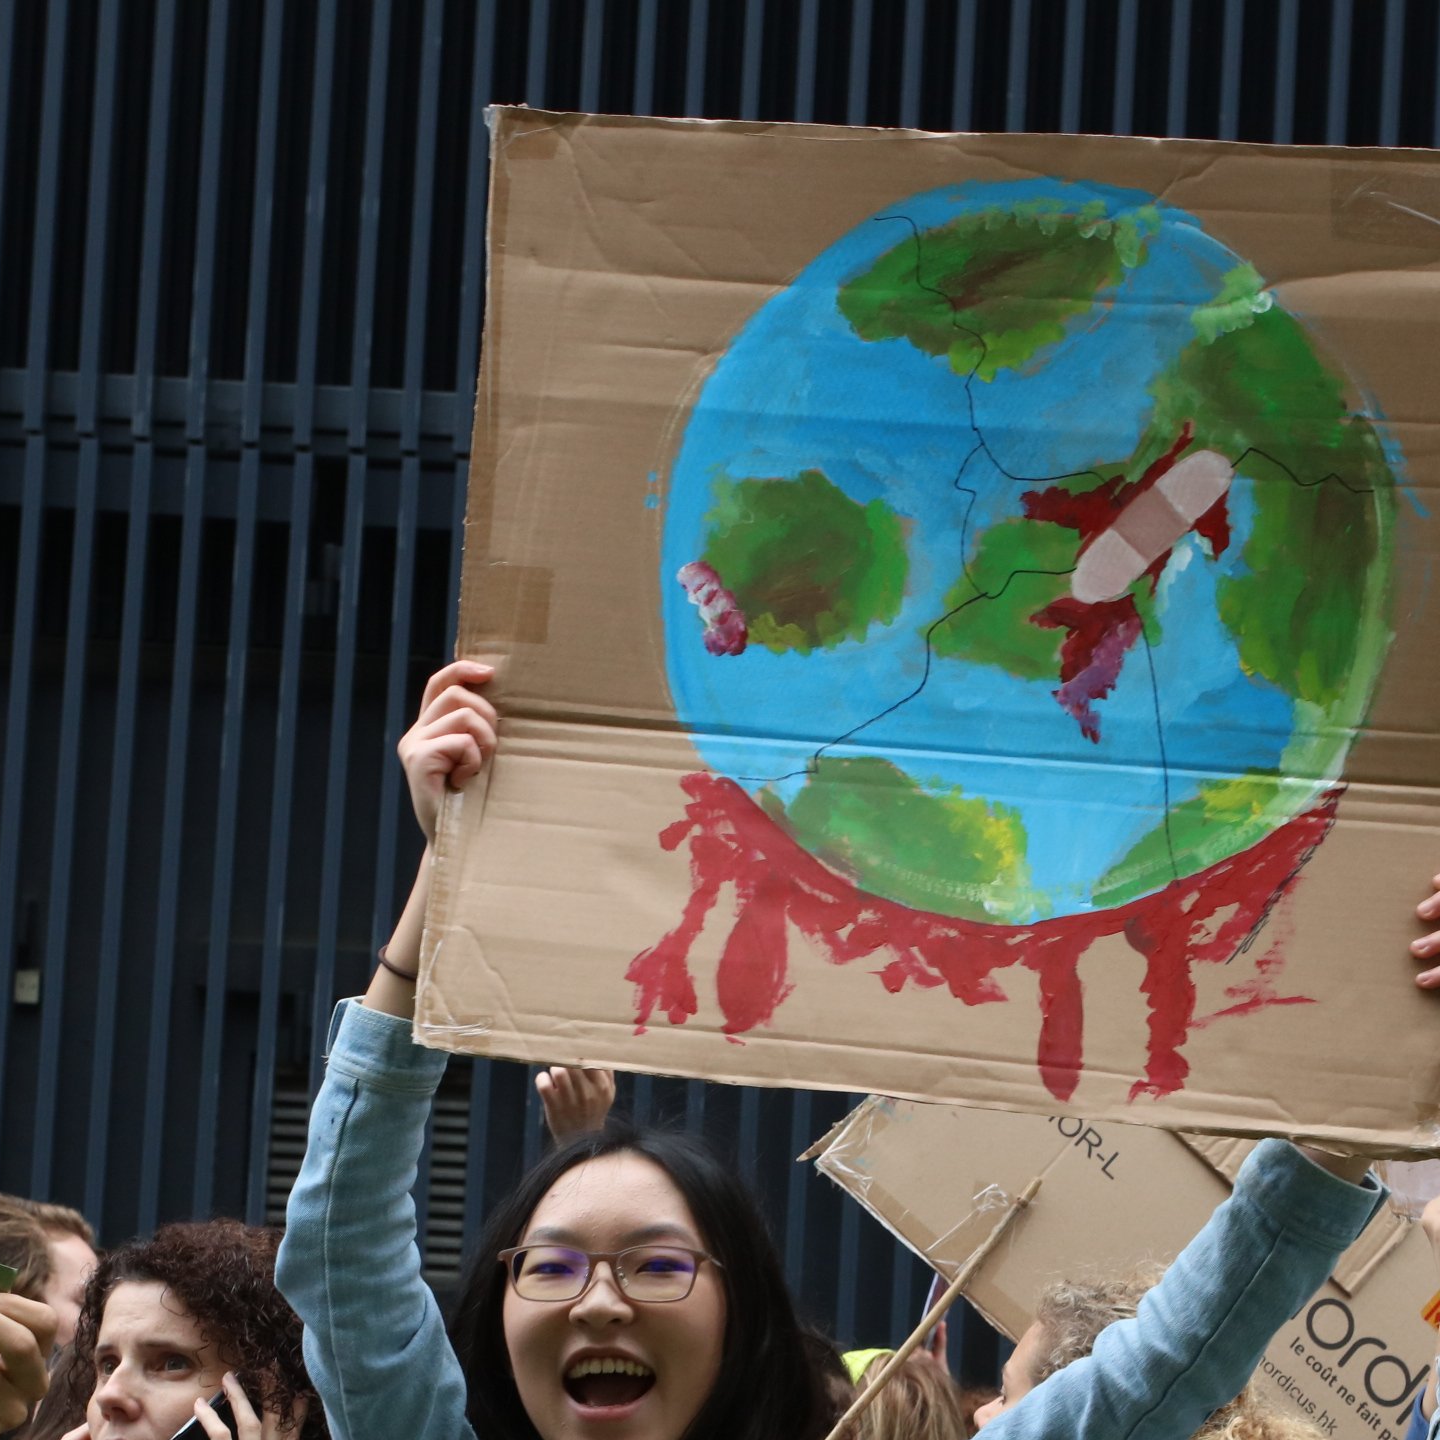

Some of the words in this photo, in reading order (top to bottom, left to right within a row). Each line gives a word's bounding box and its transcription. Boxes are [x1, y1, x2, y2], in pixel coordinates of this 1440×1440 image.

[1288, 1336, 1306, 1357] le
[1305, 1353, 1339, 1392] coût
[1336, 1383, 1357, 1407] ne
[1355, 1400, 1384, 1433] fait
